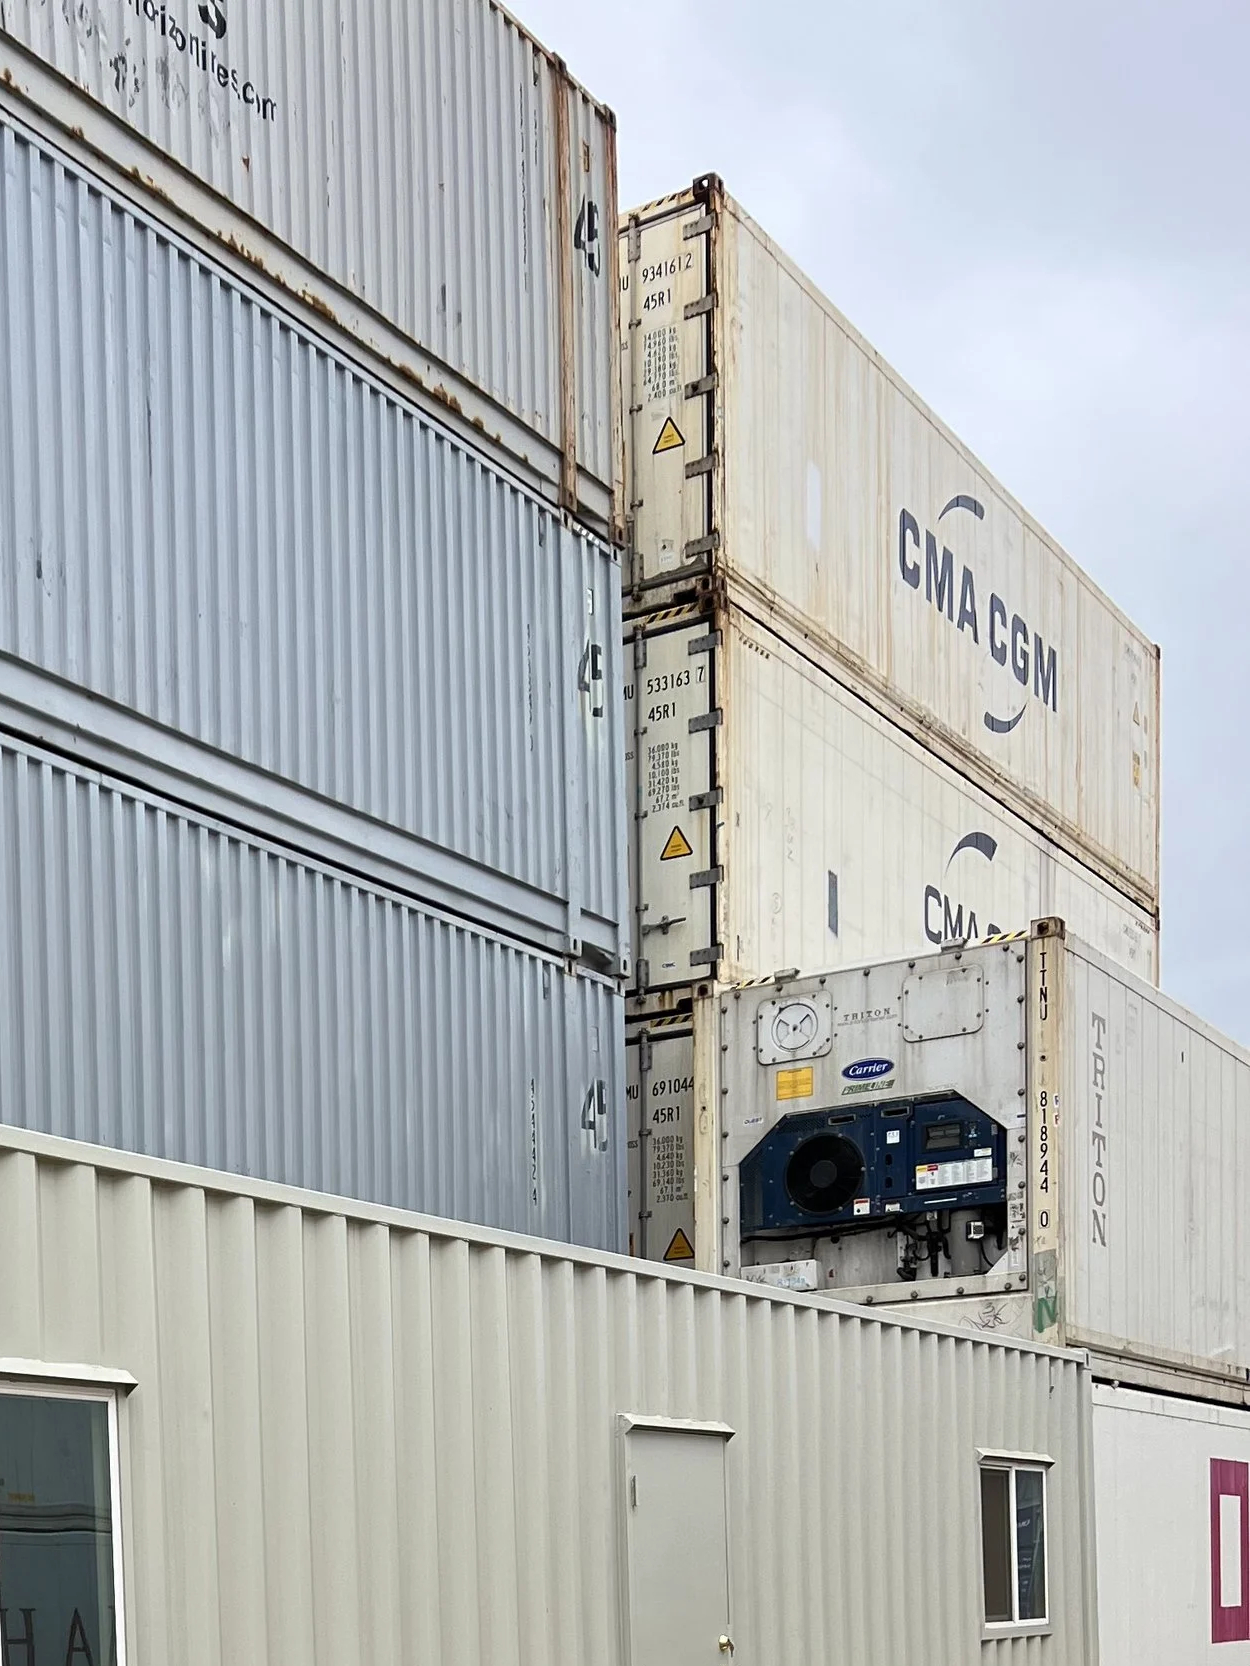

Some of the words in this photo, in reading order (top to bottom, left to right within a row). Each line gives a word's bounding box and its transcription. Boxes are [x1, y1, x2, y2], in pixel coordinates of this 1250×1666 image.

[643, 288, 671, 311] 45R1
[899, 507, 979, 645] CMA
[990, 593, 1057, 713] CGM
[647, 670, 690, 695] 533163
[697, 666, 705, 682] 7
[648, 702, 676, 722] 45R1
[924, 884, 979, 945] CMA
[1039, 952, 1048, 1021] TTNU
[843, 1007, 891, 1021] TRITON
[848, 1062, 889, 1076] Carrier
[653, 1106, 680, 1124] 45R1
[1039, 1091, 1048, 1193] 818944
[1092, 1012, 1106, 1247] TRITON
[1040, 1211, 1048, 1228] 0
